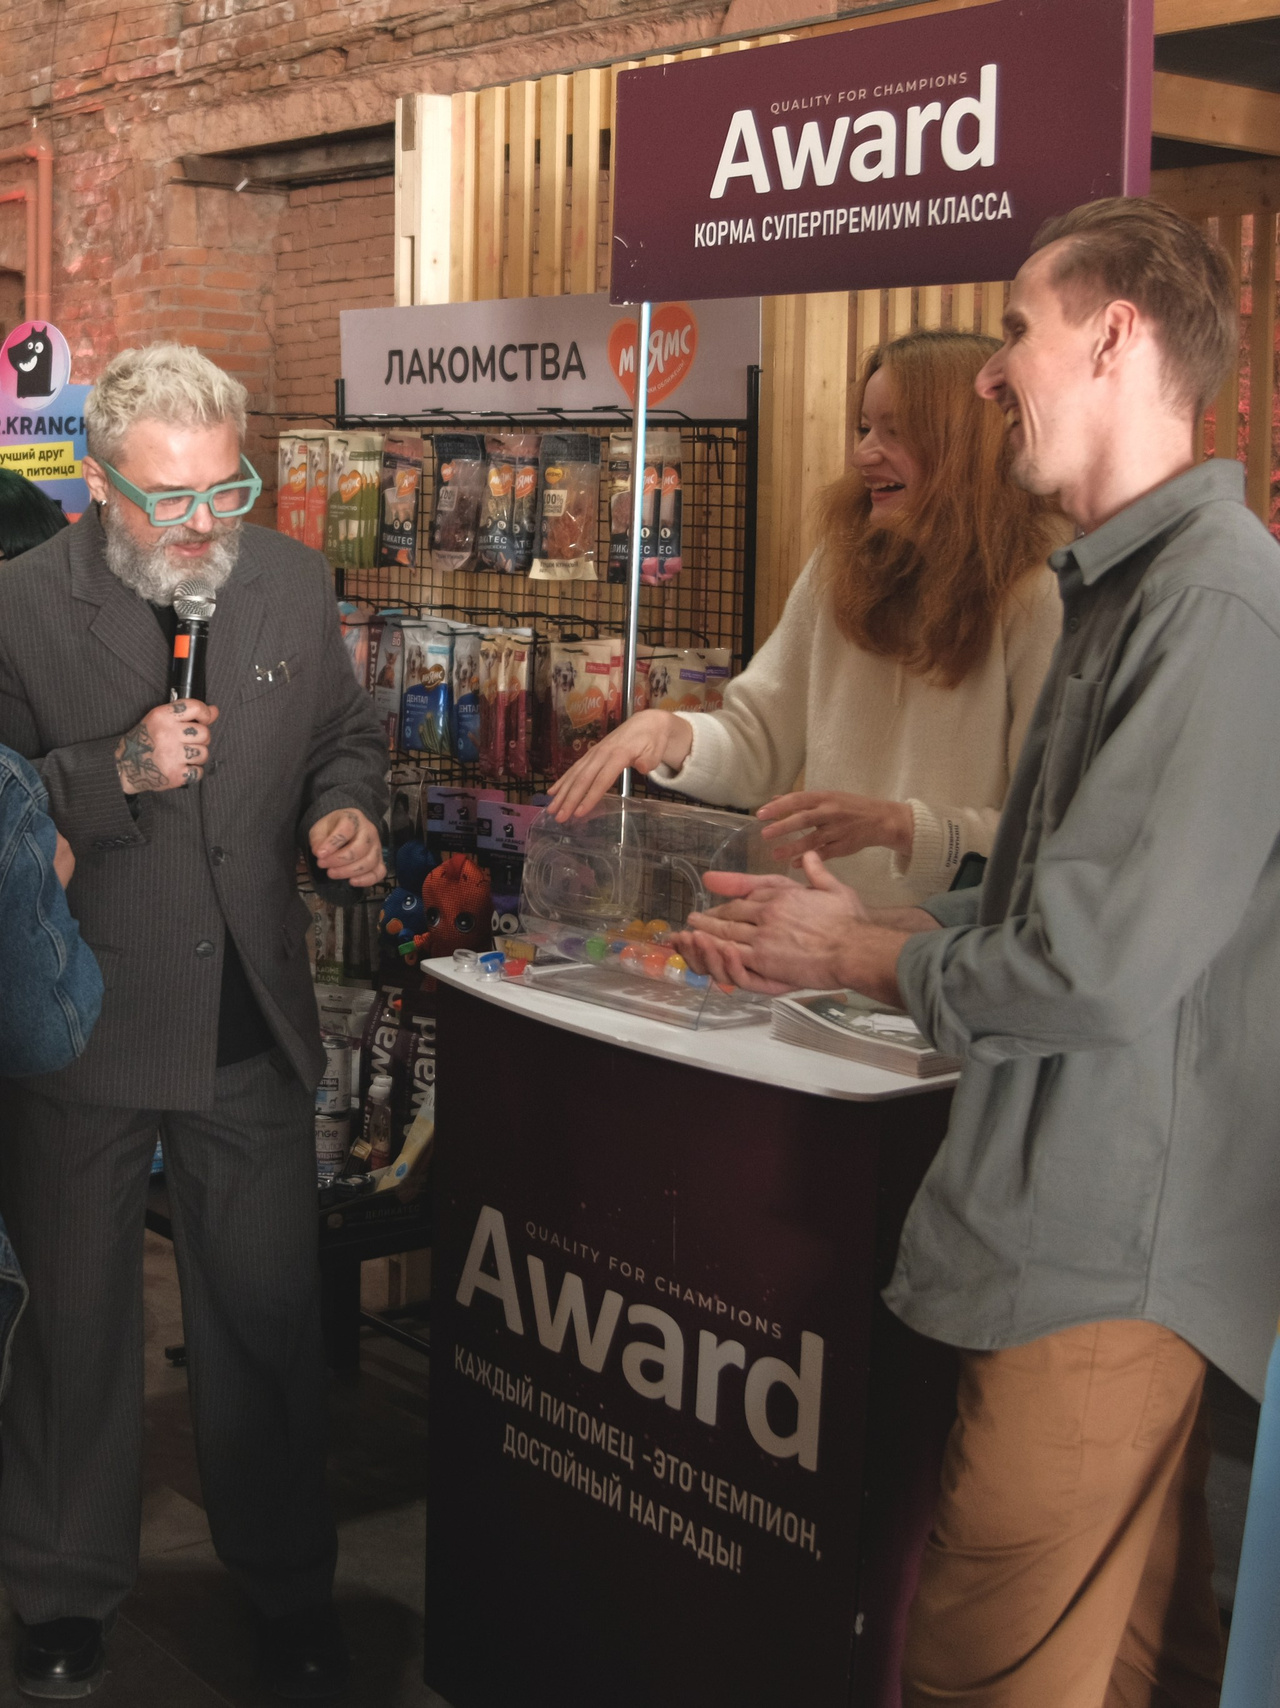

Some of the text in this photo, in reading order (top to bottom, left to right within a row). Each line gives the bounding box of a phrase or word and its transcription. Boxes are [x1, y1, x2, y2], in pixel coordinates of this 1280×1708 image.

[709, 63, 997, 199] Award
[770, 71, 968, 115] QUALITY FOR CHAMPIONS
[694, 191, 1012, 248] КОРМА СУПЕРПРЕМИУМ КЛАССА
[384, 341, 587, 385] ЛАКОМСТВА
[619, 324, 691, 378] МЯМС
[26, 465, 75, 477] питомца
[38, 448, 64, 462] друг
[370, 984, 404, 1080] ward
[525, 1220, 783, 1339] QUALITY FOR CHAMPIONS
[455, 1204, 825, 1473] Award
[454, 1343, 533, 1412] КАЖДЫЙ
[540, 1390, 635, 1470] ПИТОМЕЦ
[700, 1475, 822, 1561] ЧЕМПИОН,
[503, 1423, 743, 1574] ДОСТОЙНЫЙ НАГРАДЫ!
